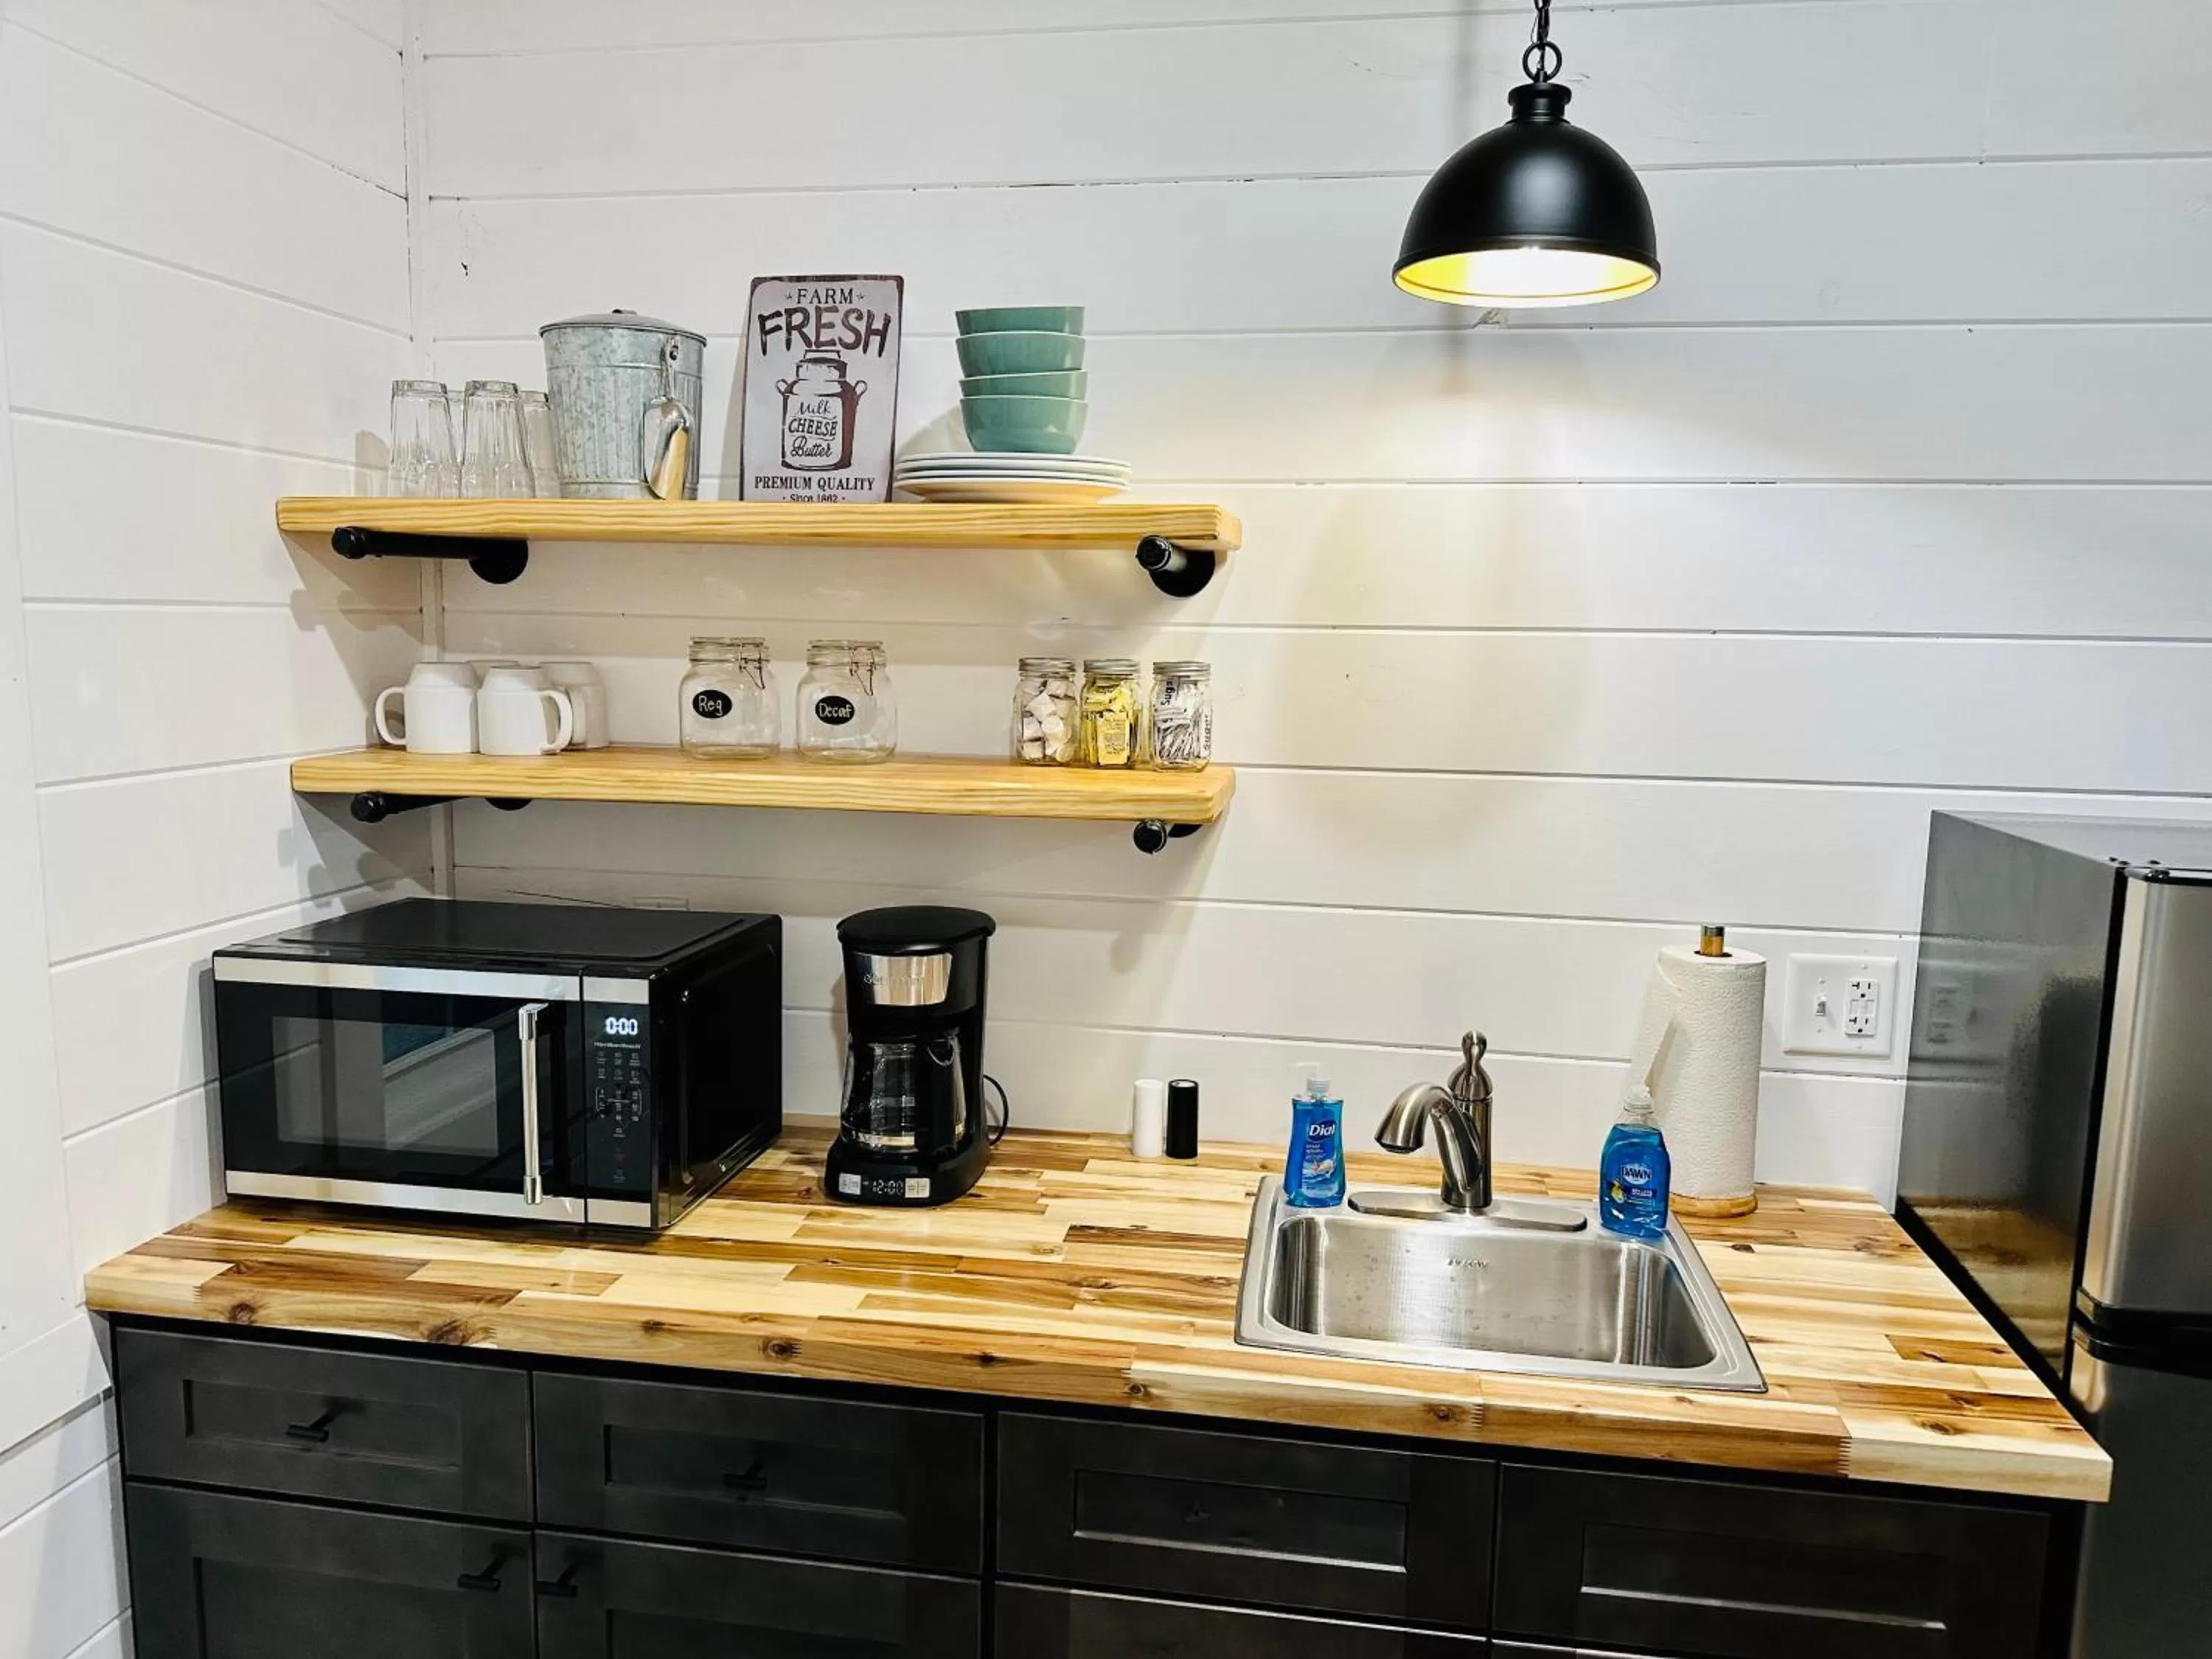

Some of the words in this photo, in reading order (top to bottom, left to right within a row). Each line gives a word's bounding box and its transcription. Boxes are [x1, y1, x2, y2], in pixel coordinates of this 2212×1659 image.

[796, 288, 854, 305] FARM
[757, 305, 891, 358] FRESH
[796, 399, 831, 415] Milk
[788, 418, 838, 437] CHEESE
[790, 435, 832, 457] Butter
[754, 476, 812, 490] PREMIUM
[818, 477, 876, 492] QUALITY
[698, 695, 723, 716] Reg
[818, 702, 852, 719] Decaf
[605, 1017, 638, 1034] 0:00
[1309, 1124, 1335, 1136] Dial
[1622, 1166, 1652, 1180] DAWN
